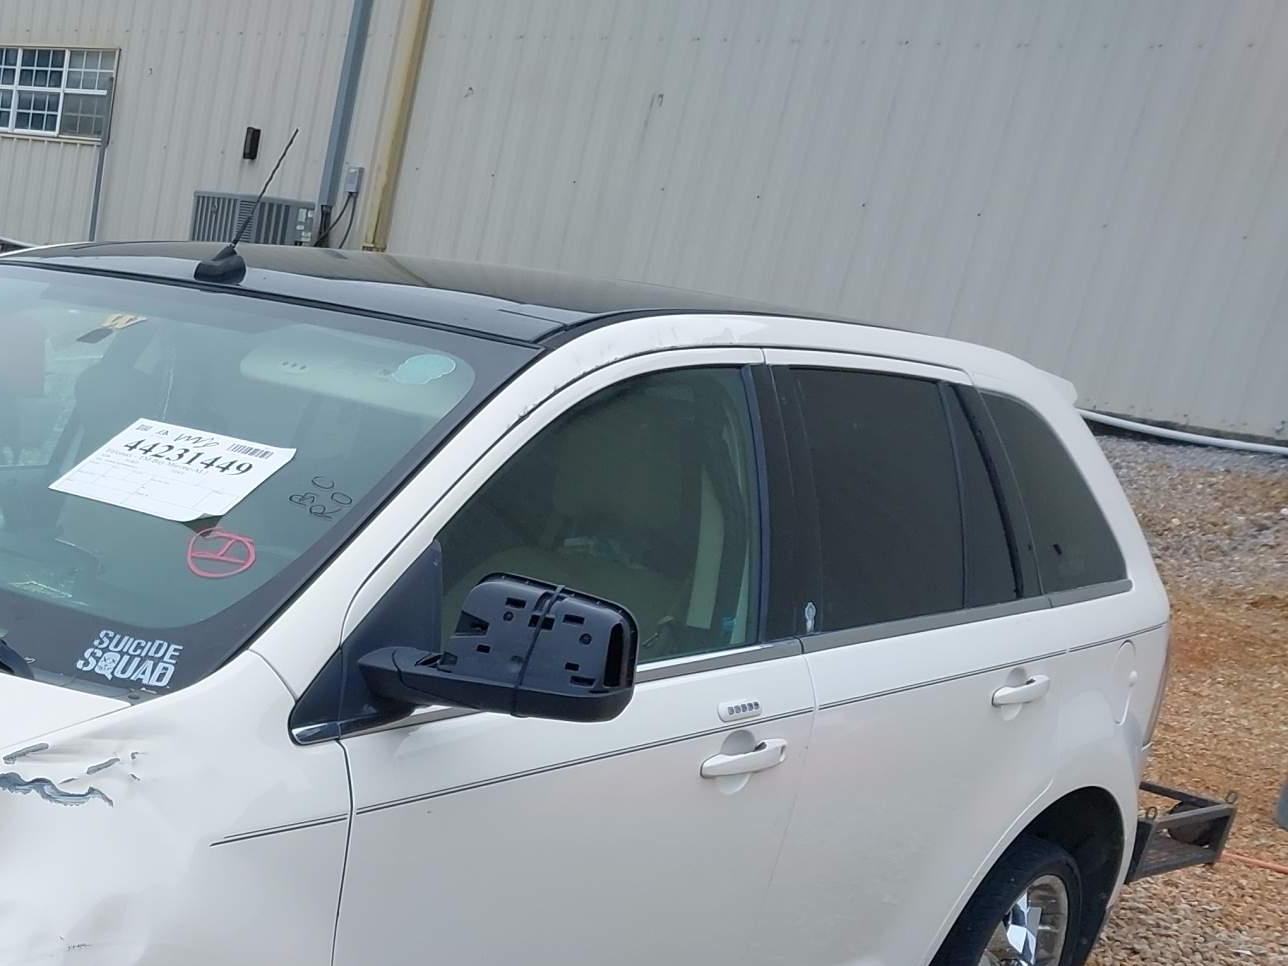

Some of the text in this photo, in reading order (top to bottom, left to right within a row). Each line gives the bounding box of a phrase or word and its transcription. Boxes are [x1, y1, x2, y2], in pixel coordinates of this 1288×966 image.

[123, 438, 253, 476] 44231449
[93, 629, 184, 664] SUICIDE
[76, 647, 176, 688] SQUAD
